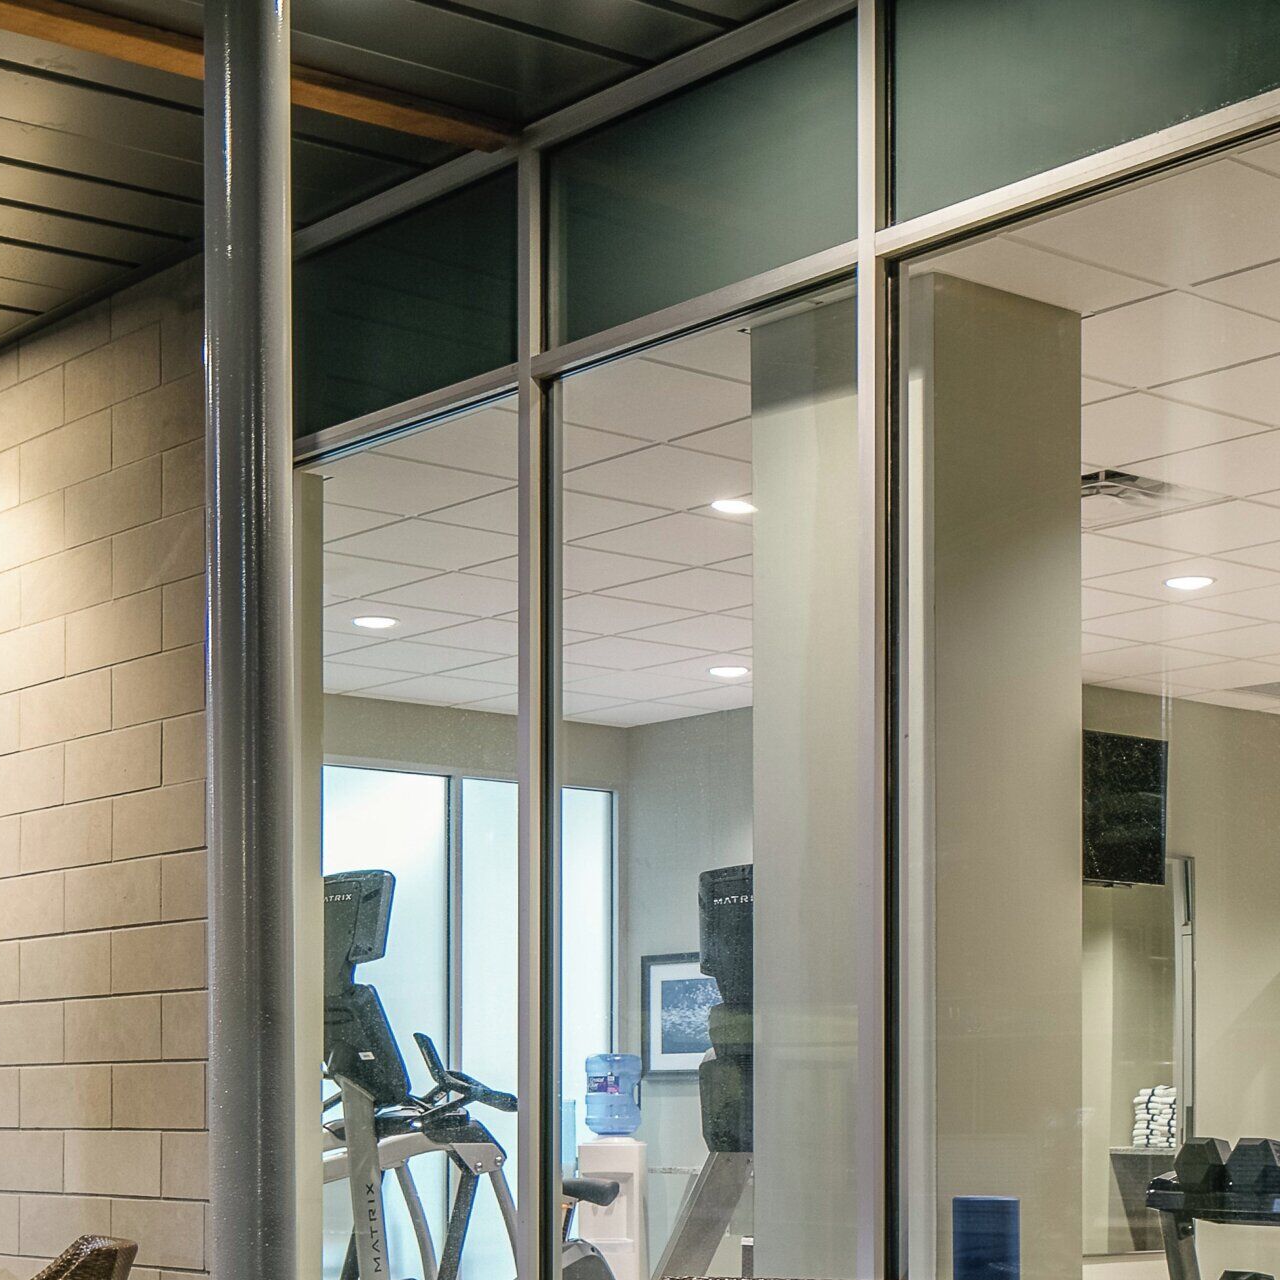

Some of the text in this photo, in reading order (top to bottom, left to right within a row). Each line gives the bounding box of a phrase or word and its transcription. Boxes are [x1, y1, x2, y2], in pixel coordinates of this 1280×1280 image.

[323, 893, 353, 903] ATRIX
[713, 895, 754, 905] MATRI
[365, 1183, 382, 1273] MATRIX
